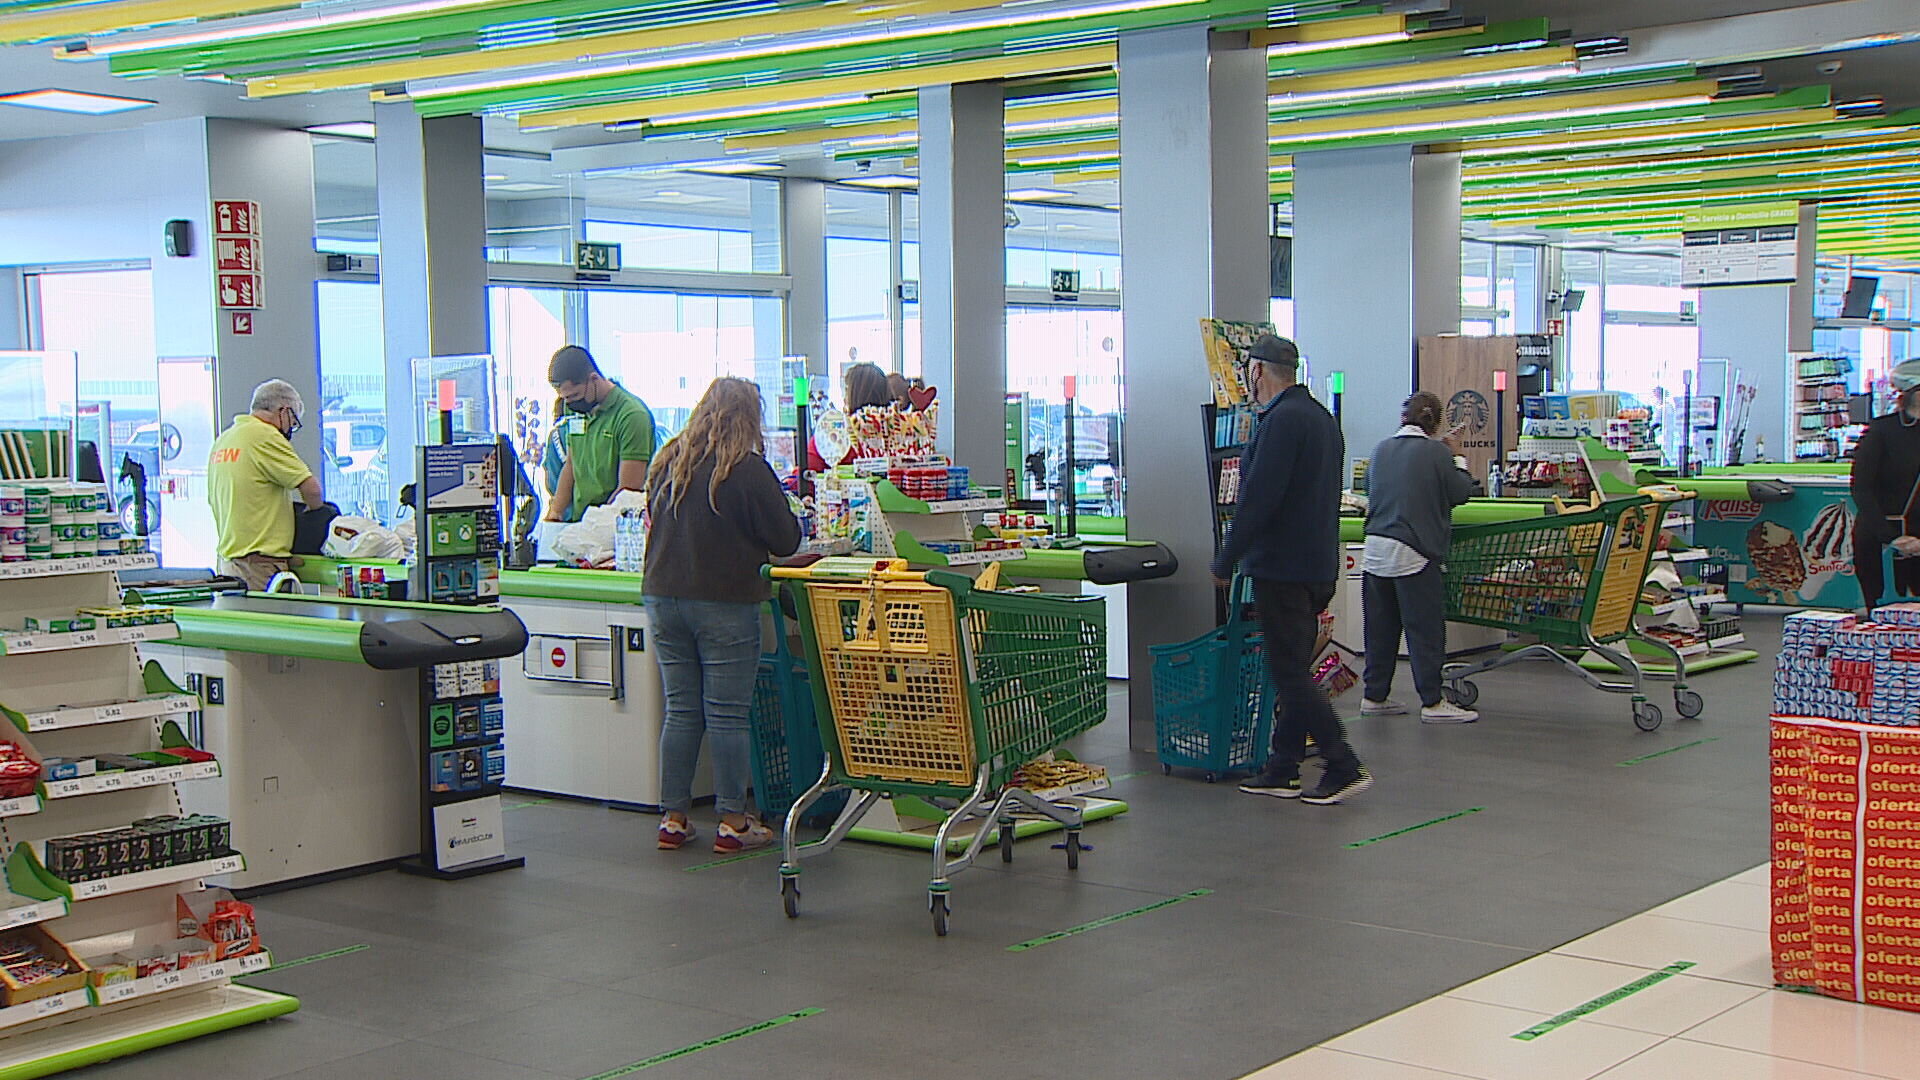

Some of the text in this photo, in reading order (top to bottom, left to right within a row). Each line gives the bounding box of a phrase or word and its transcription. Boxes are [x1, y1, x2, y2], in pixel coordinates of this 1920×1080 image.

[1519, 346, 1551, 356] STARBUCKS
[1704, 500, 1761, 520] Kalise
[632, 632, 640, 647] 4
[211, 683, 219, 699] 3
